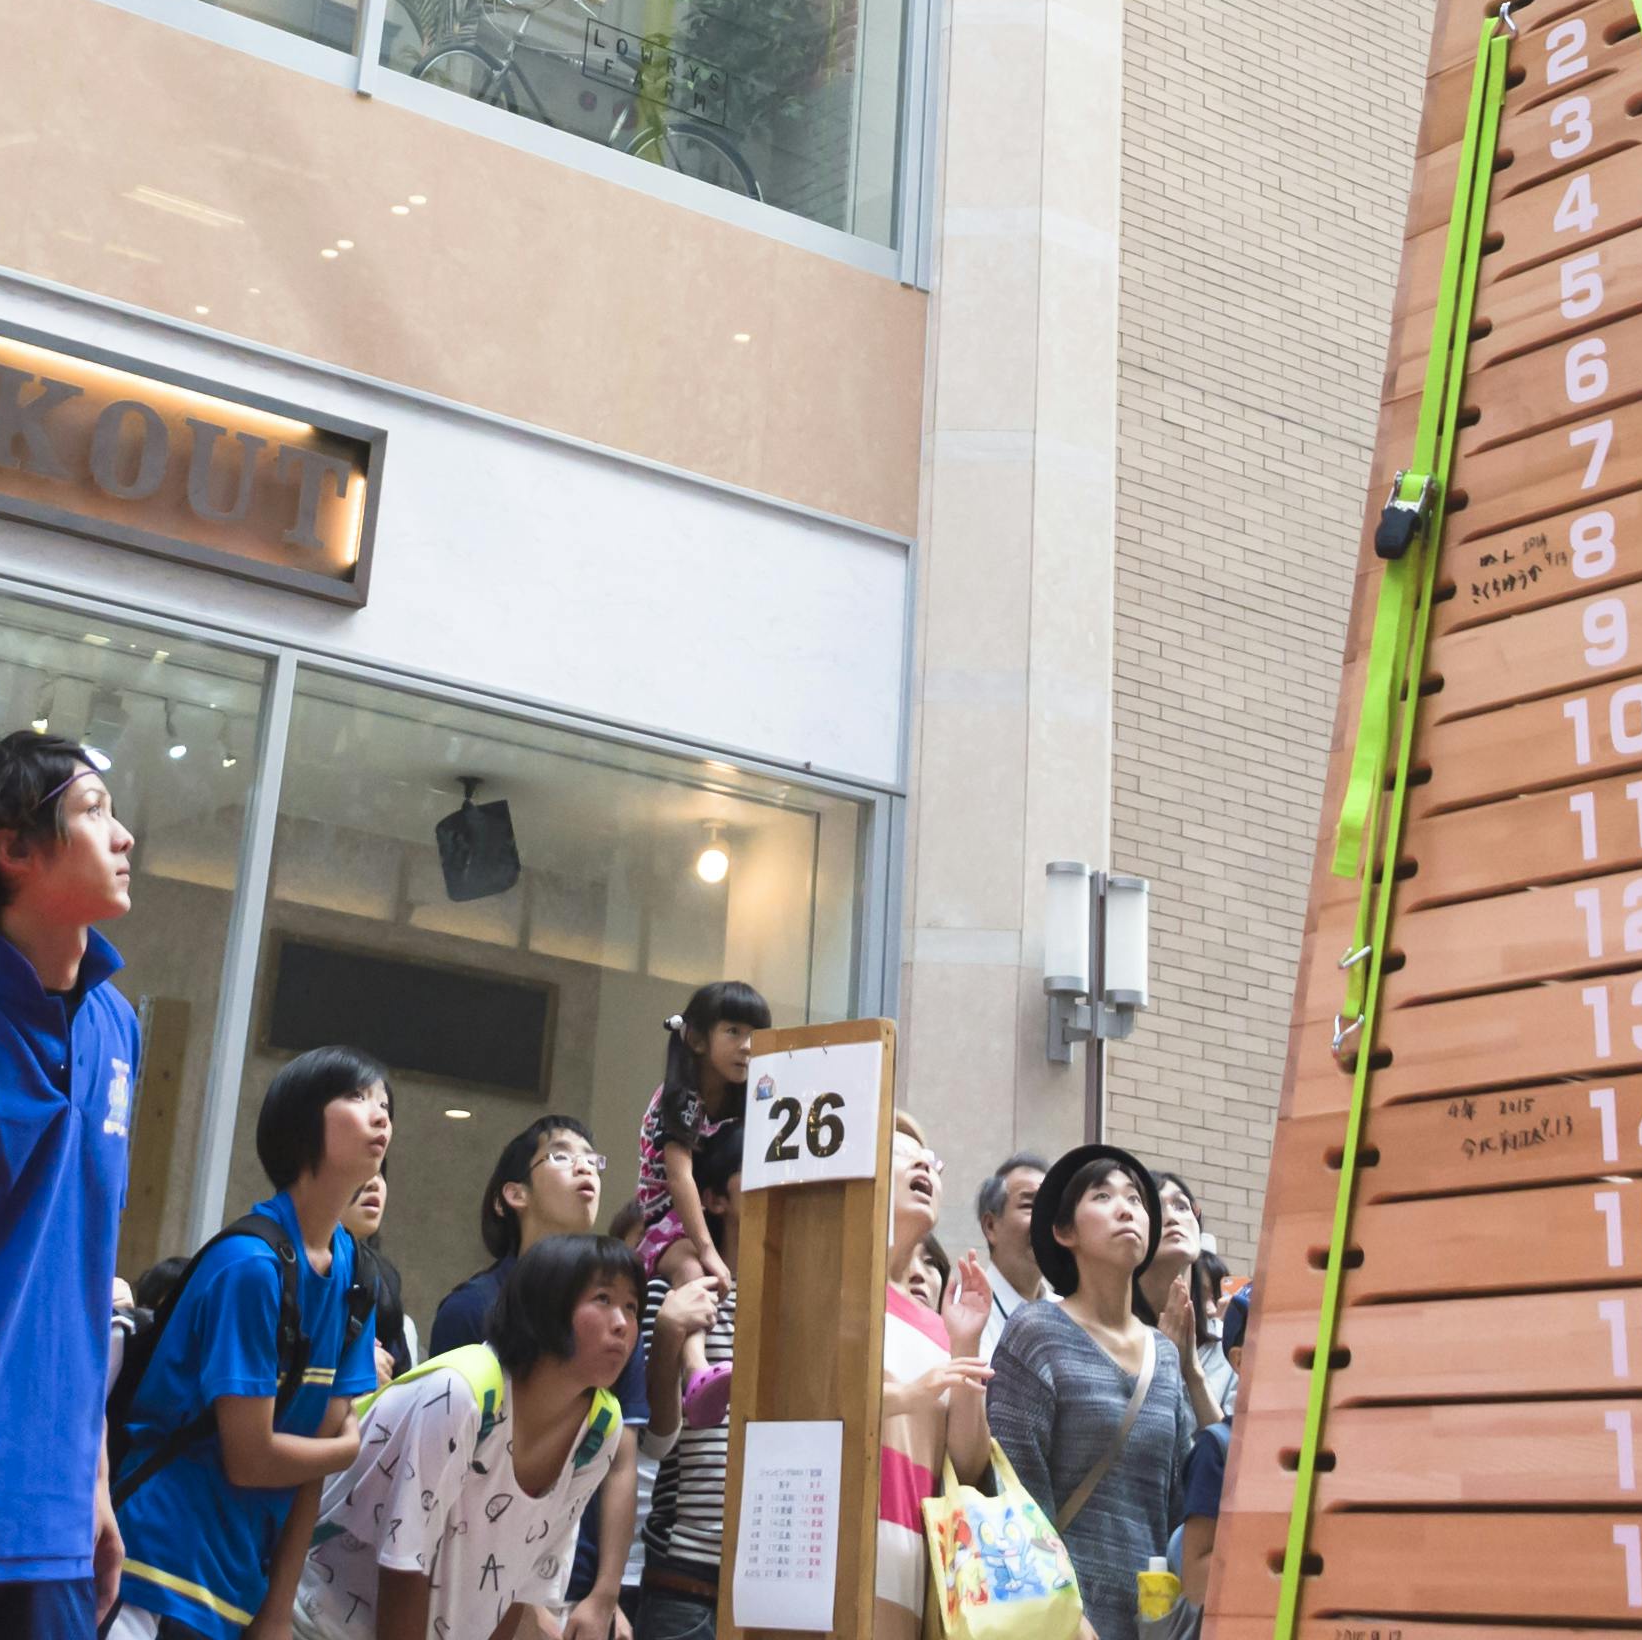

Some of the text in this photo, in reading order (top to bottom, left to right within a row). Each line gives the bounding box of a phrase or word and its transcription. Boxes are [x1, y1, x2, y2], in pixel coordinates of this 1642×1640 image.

[1546, 20, 1587, 84] 2
[1551, 98, 1592, 159] 3
[1555, 174, 1599, 232] 4
[1561, 254, 1603, 318] 5
[1566, 339, 1608, 403] 6
[1570, 420, 1614, 488] 7
[1570, 512, 1616, 578] 8
[1583, 600, 1628, 667] 9
[764, 1092, 845, 1163] 26
